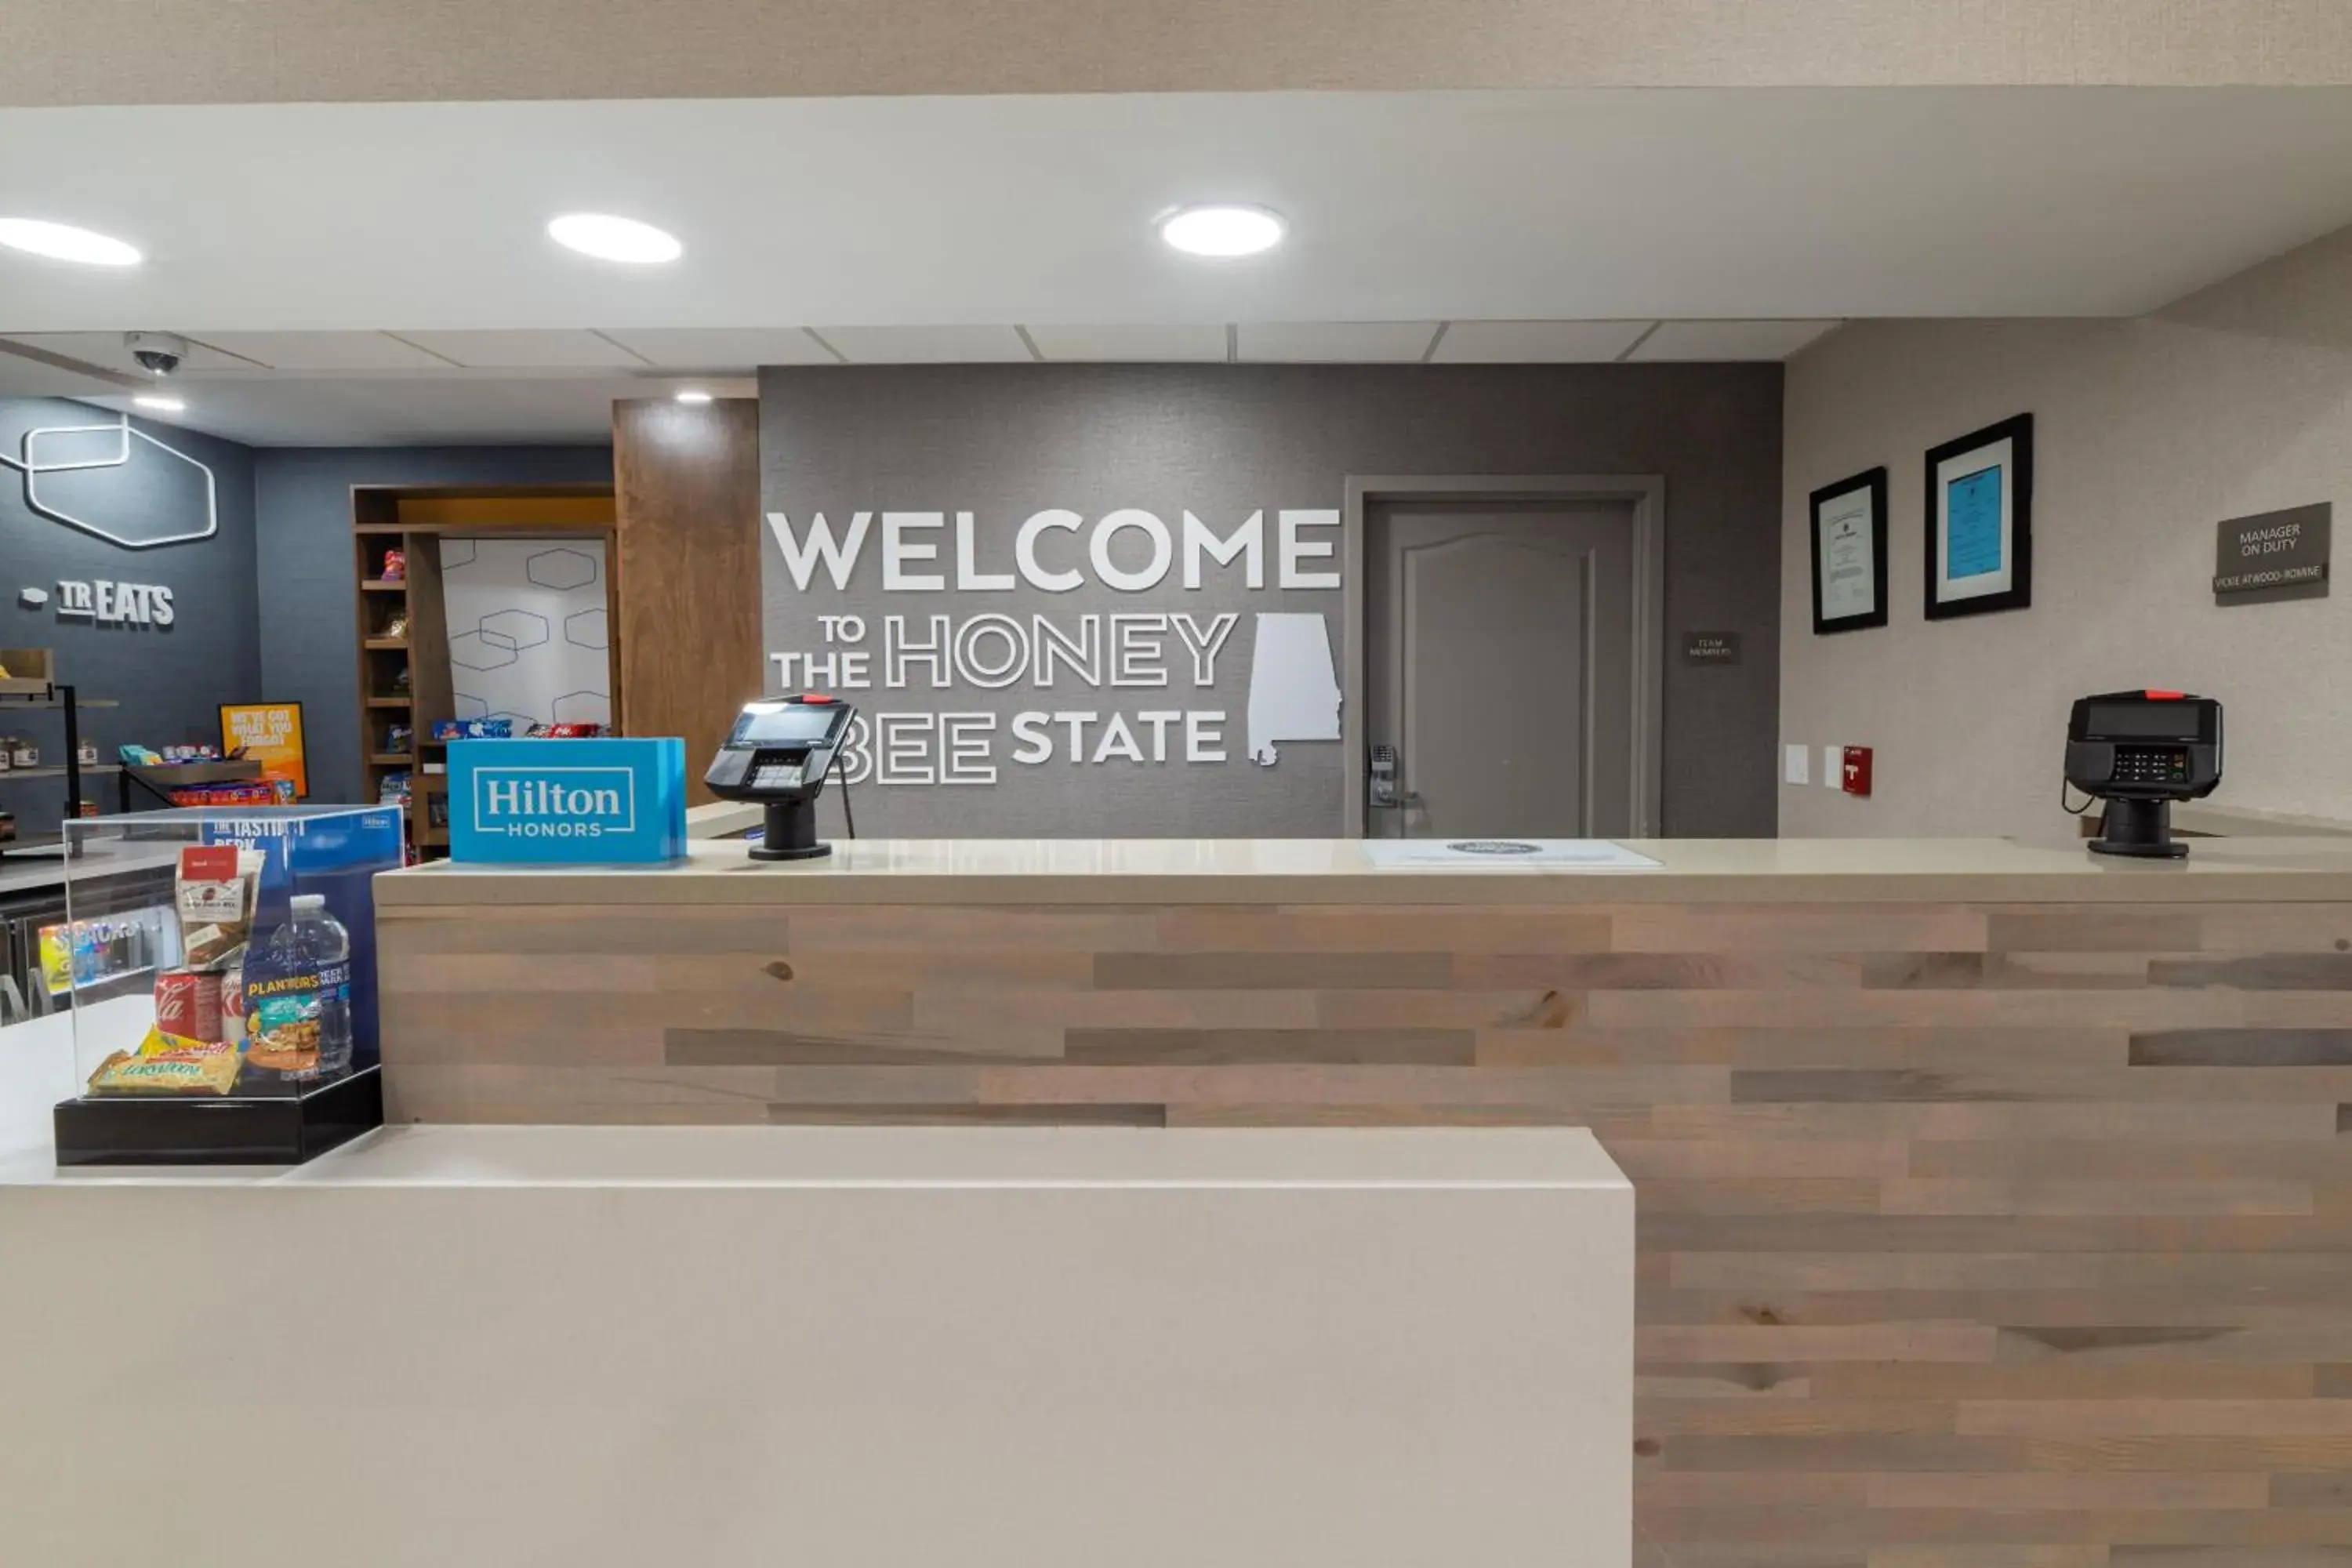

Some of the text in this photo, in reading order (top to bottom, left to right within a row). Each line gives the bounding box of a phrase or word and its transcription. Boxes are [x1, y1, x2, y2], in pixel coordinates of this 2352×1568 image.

[766, 508, 1342, 592] WELCOME
[2240, 524, 2301, 544] MANAGER
[2241, 538, 2297, 556] ON DUTY
[56, 579, 174, 626] TREATS
[818, 615, 865, 643] TO
[770, 612, 1240, 688] THE HONEY
[826, 710, 1227, 786] BEE STATE
[486, 779, 622, 815] Hilton
[508, 822, 601, 837] HONORS
